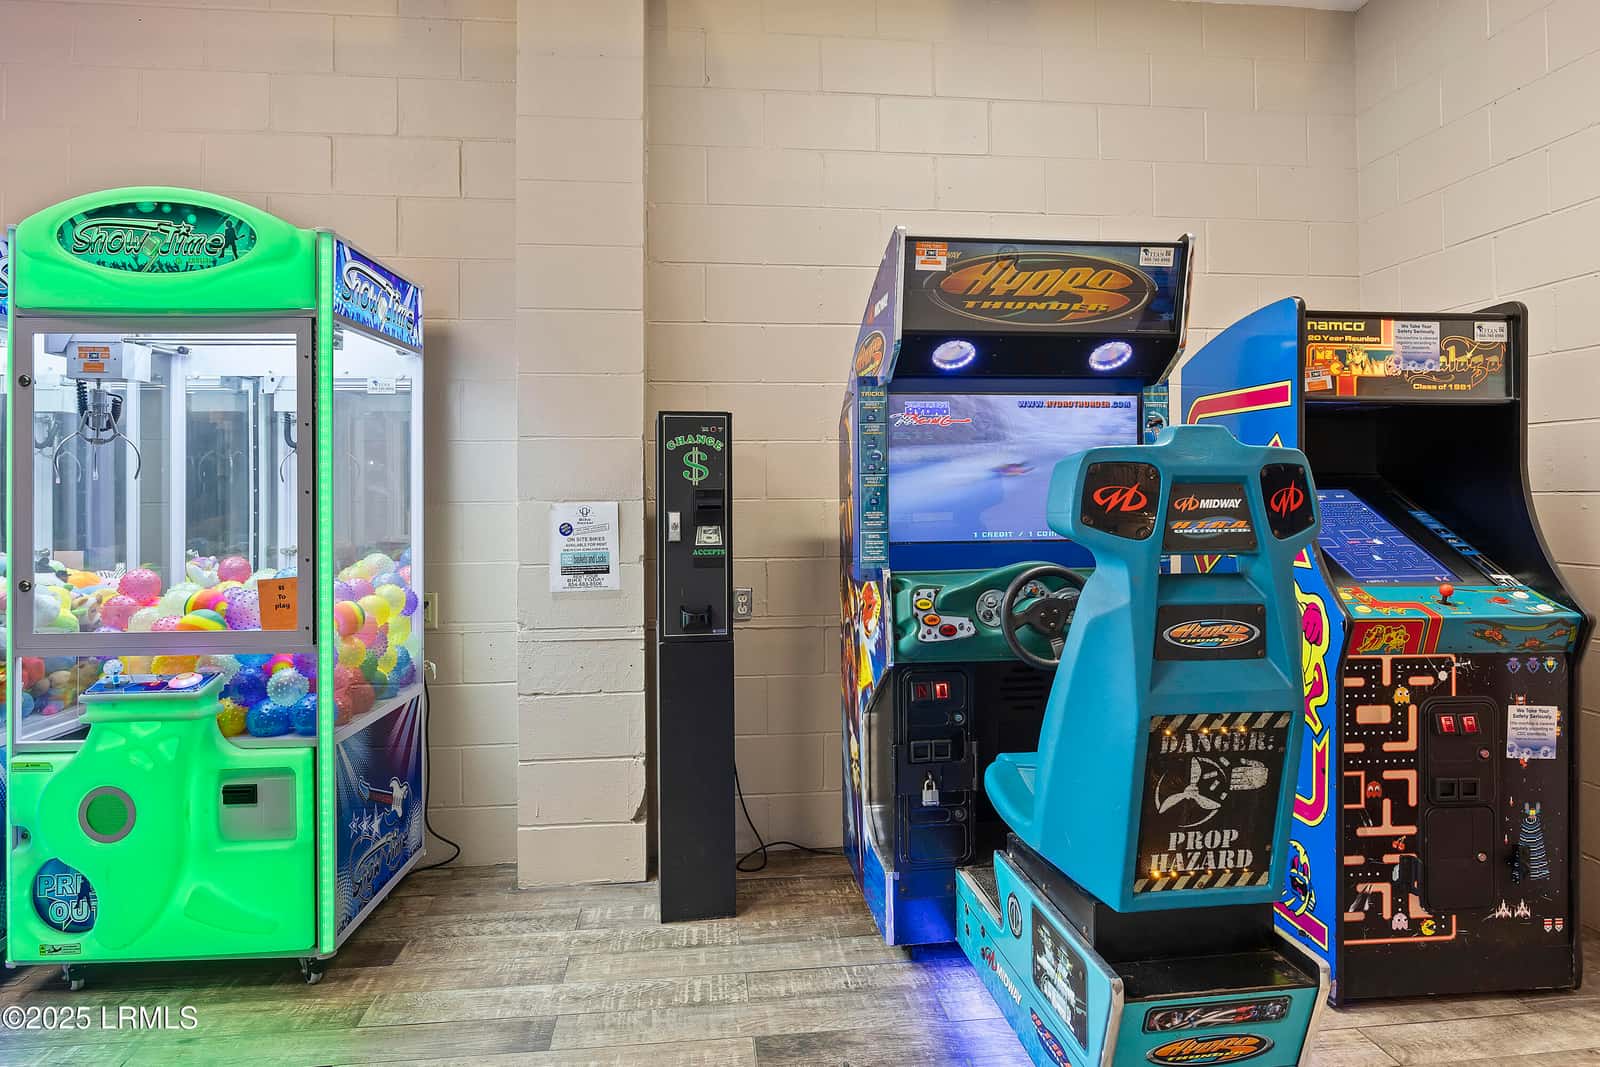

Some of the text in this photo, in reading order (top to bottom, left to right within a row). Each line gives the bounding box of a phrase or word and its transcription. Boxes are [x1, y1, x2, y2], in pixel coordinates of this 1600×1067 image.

[963, 300, 1111, 314] THUNDER
[1307, 321, 1366, 331] namco
[666, 434, 724, 451] CHANGE
[1199, 498, 1242, 509] MIDWAY
[982, 530, 1013, 538] CREDIT
[275, 603, 291, 611] play
[1160, 731, 1276, 754] DANGER:
[1168, 829, 1239, 851] PROP
[1150, 849, 1253, 873] HAZARD
